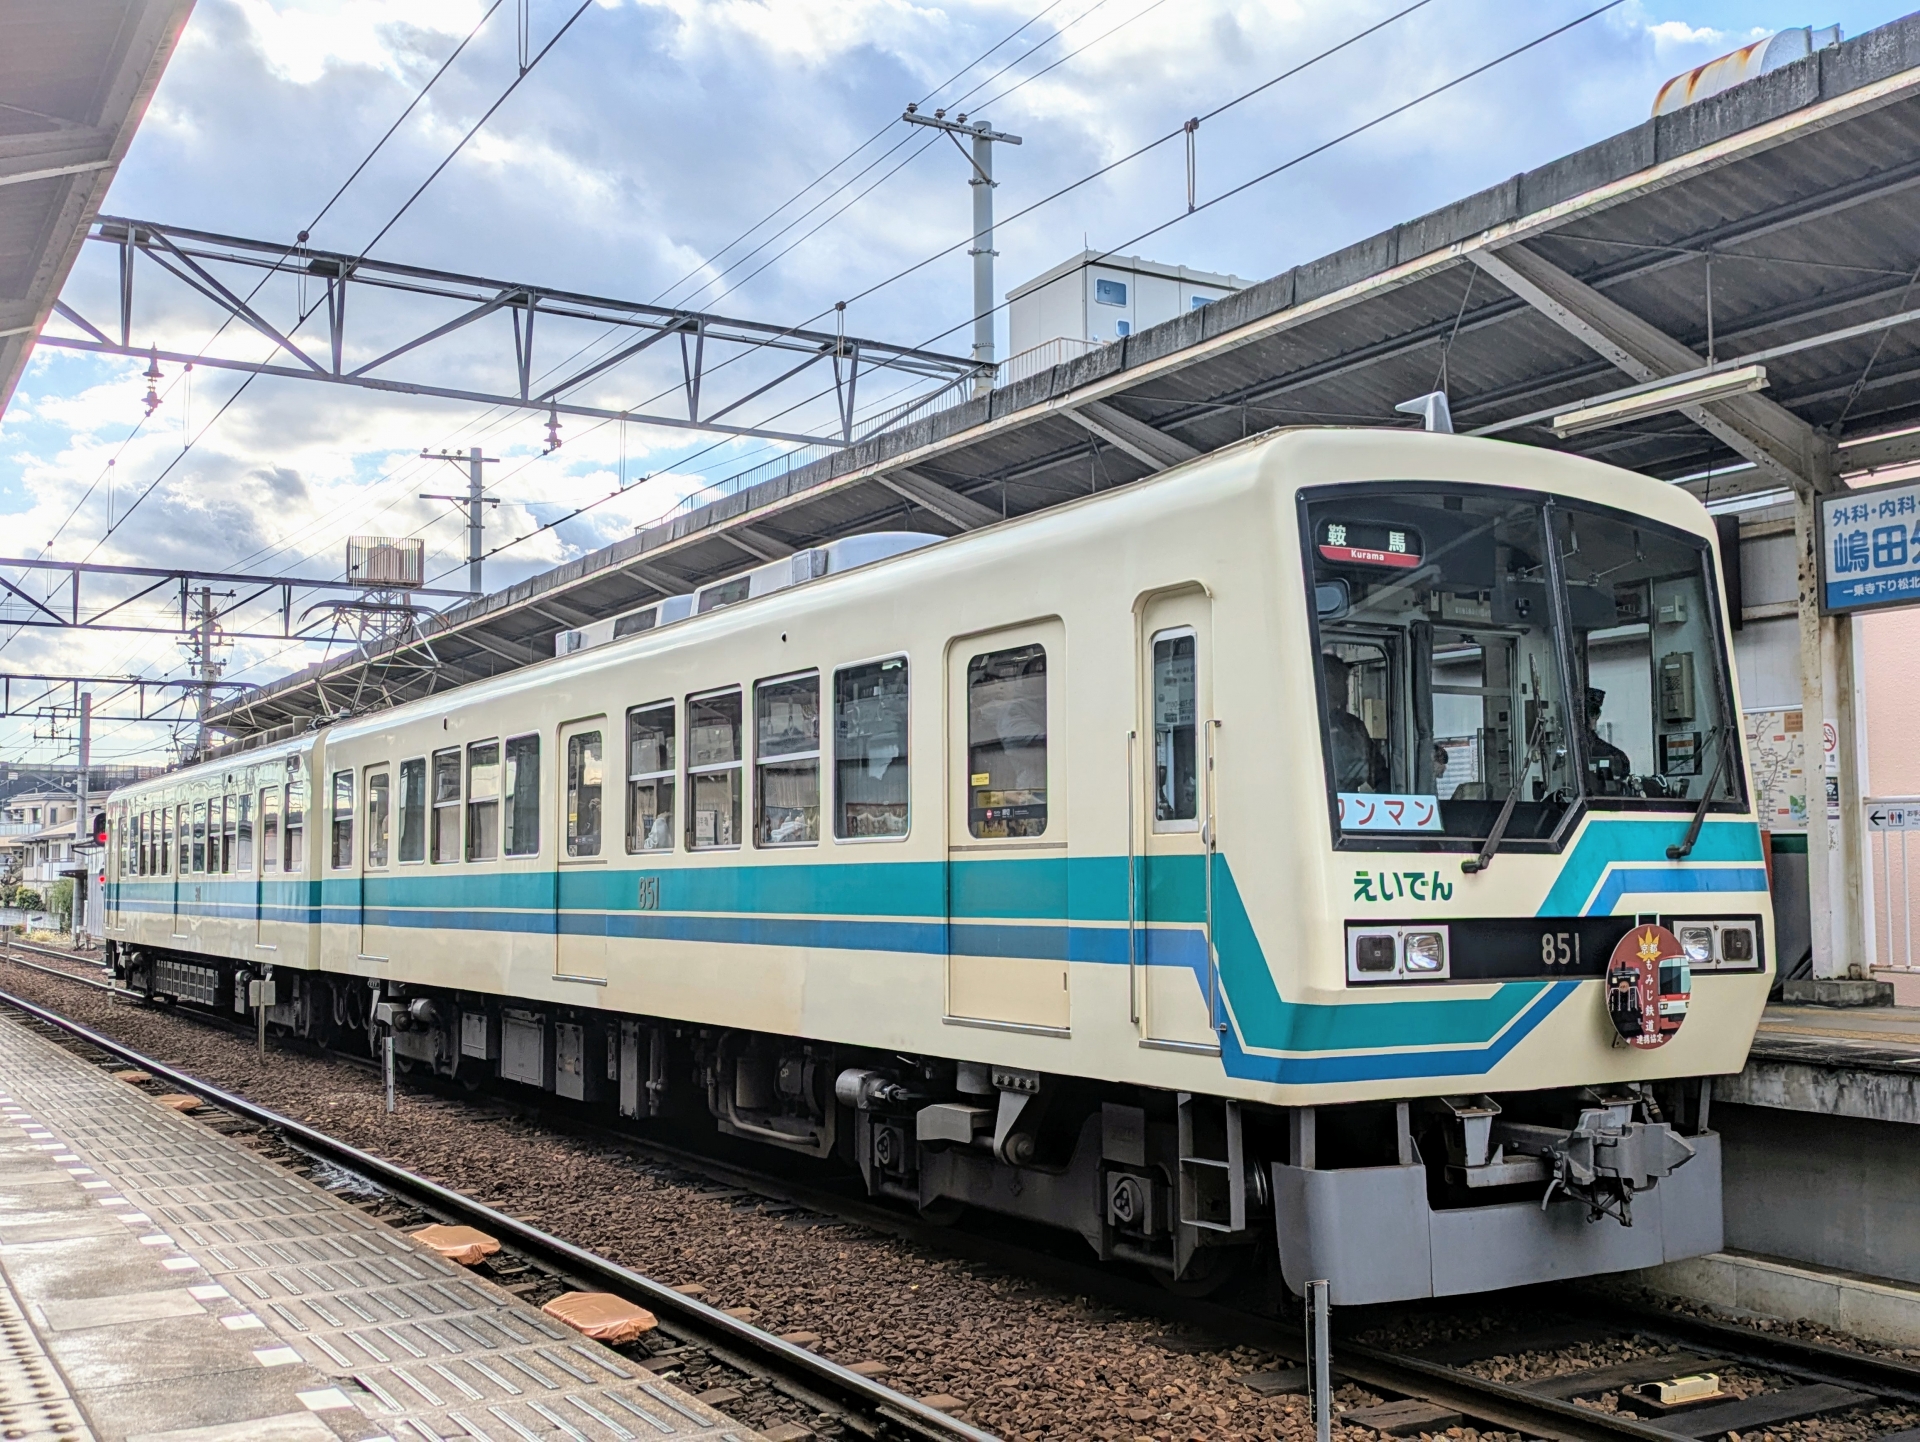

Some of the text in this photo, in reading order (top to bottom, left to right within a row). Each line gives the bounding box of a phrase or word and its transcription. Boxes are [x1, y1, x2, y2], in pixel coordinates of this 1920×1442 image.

[1327, 523, 1406, 553] 鞍馬
[1350, 548, 1385, 561] Kurama
[639, 876, 660, 910] 851
[1353, 870, 1453, 902] えいでん
[1541, 932, 1580, 965] 851
[1640, 943, 1658, 956] 京都
[1645, 959, 1655, 1032] もみじ鉄道
